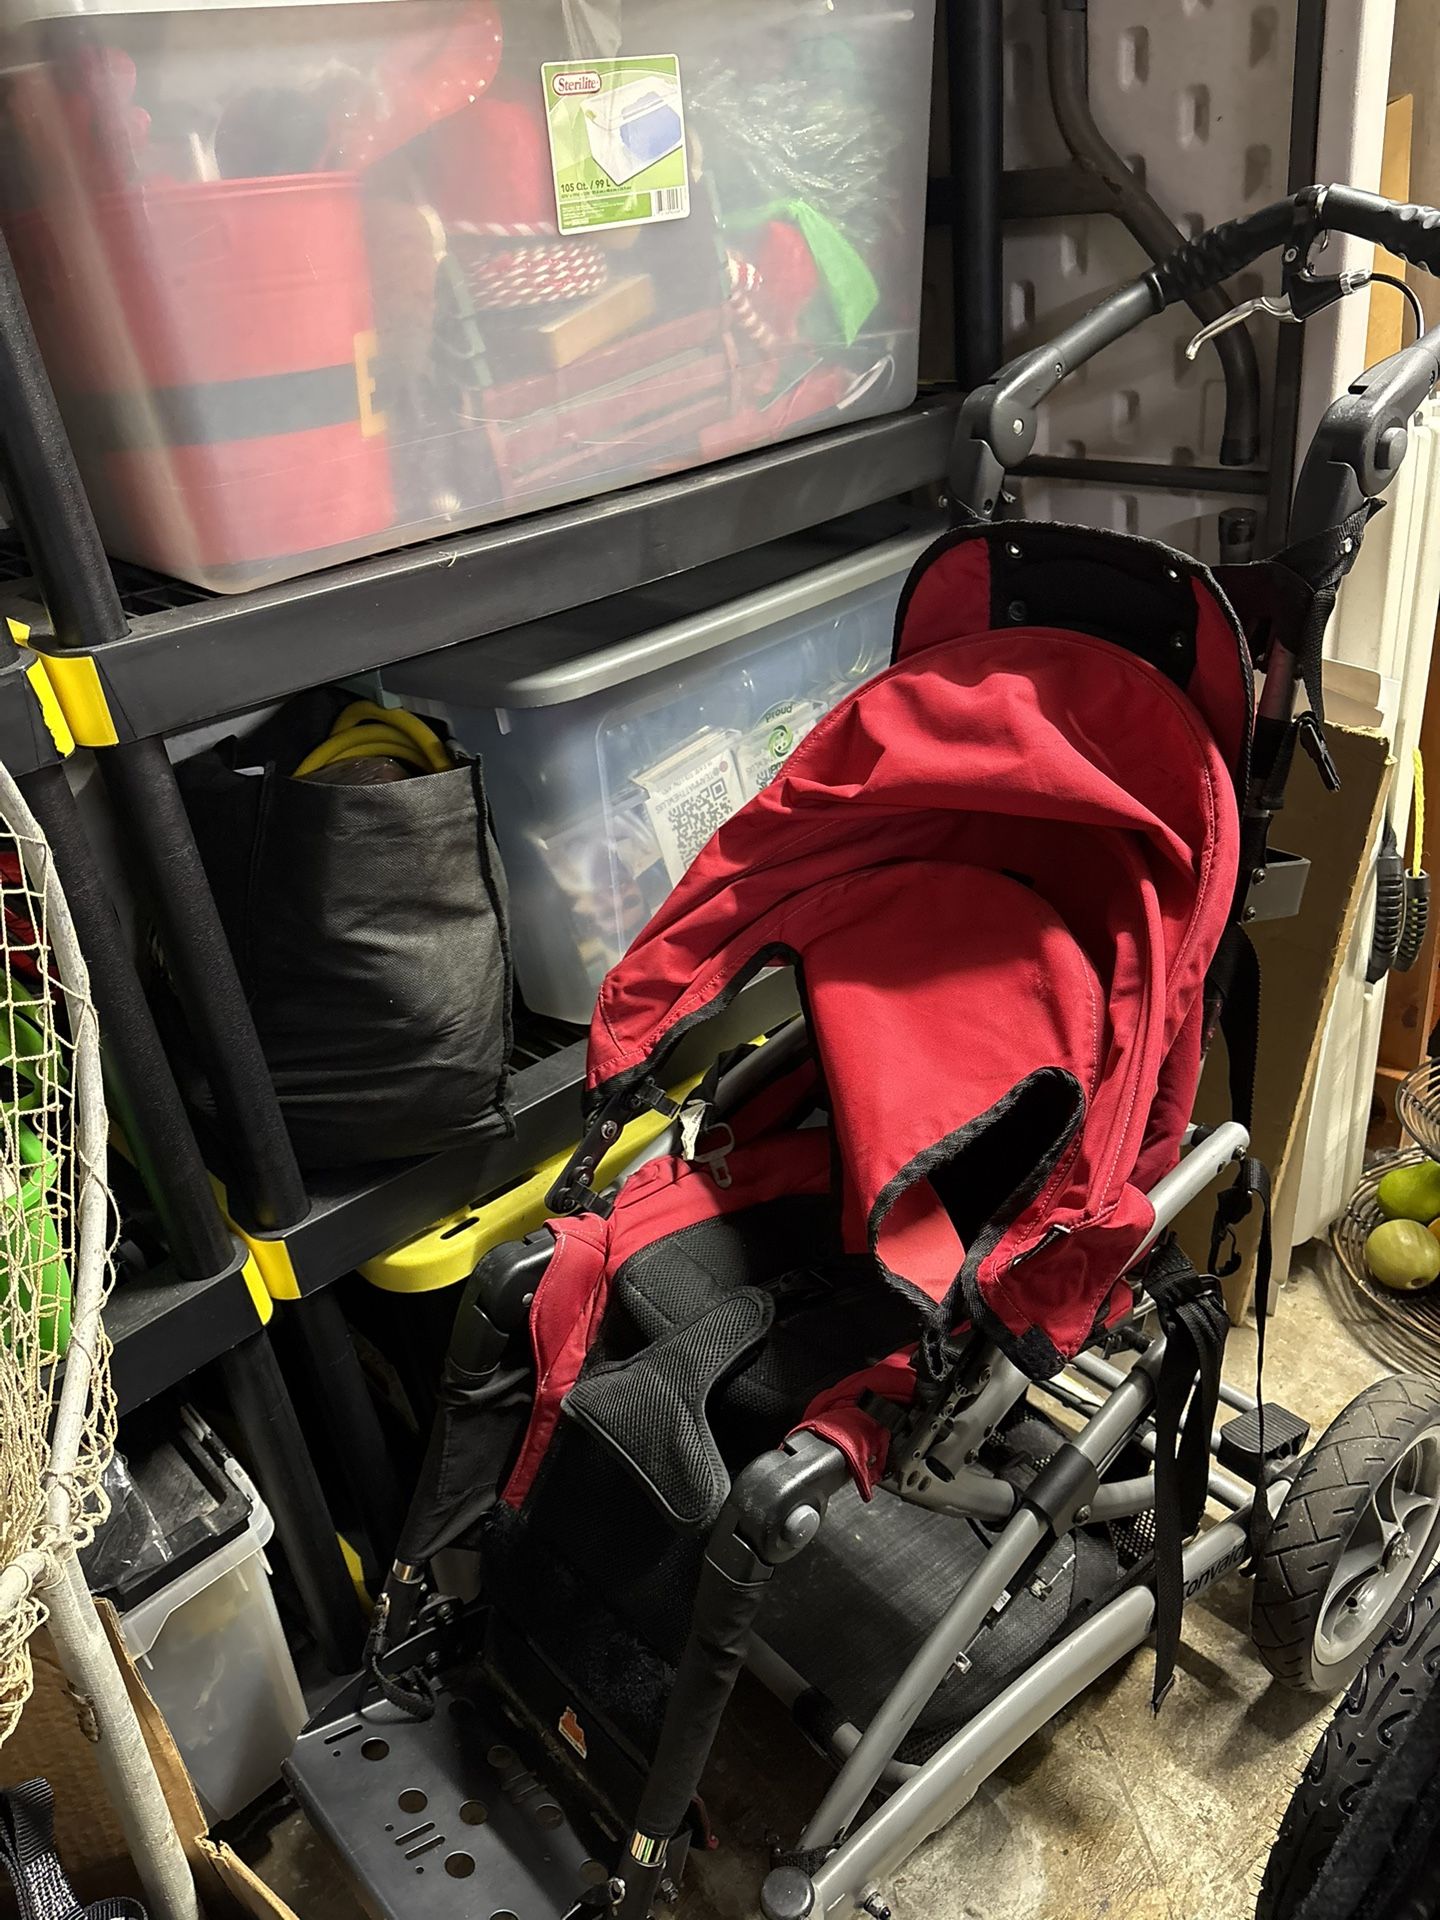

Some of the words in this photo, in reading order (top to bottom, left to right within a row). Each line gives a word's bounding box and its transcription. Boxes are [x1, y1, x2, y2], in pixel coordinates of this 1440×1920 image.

[558, 75, 597, 92] Sterilite
[560, 183, 575, 193] 105
[595, 179, 605, 189] 99
[606, 178, 611, 187] L
[1182, 1539, 1247, 1598] onvaid
